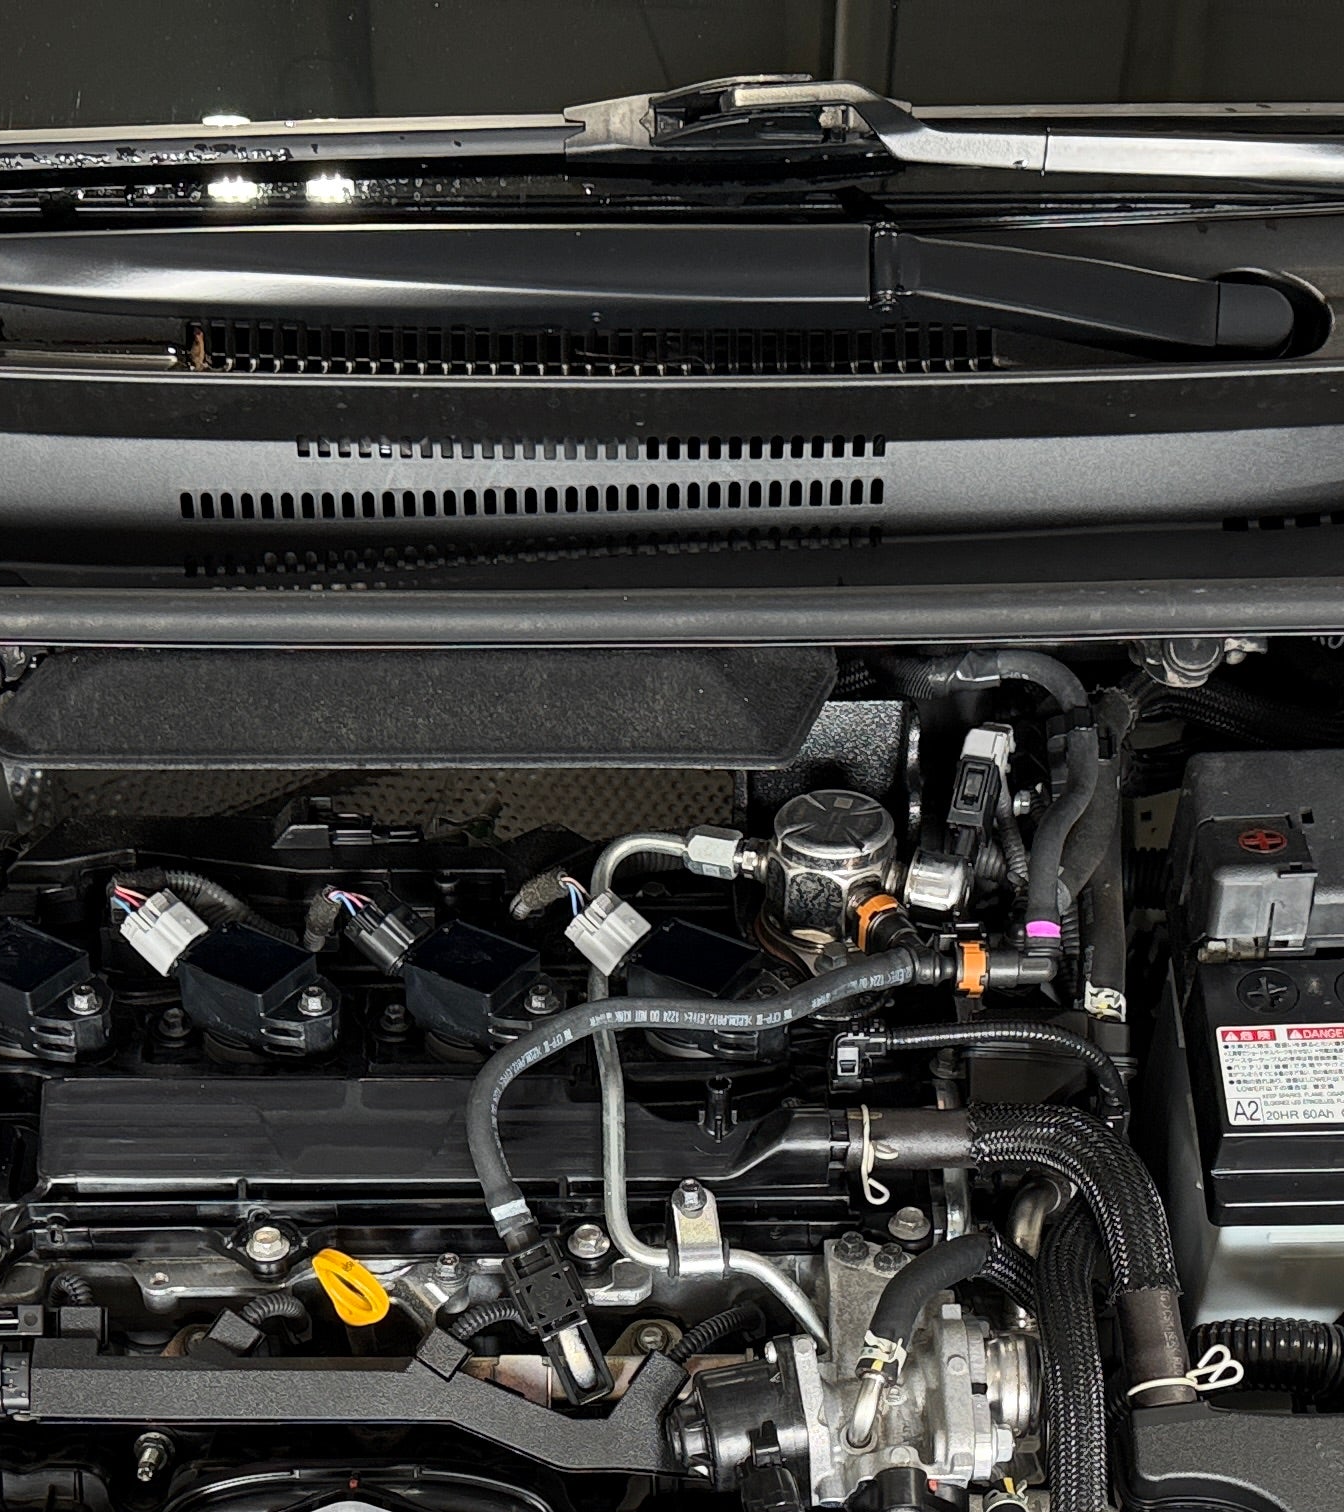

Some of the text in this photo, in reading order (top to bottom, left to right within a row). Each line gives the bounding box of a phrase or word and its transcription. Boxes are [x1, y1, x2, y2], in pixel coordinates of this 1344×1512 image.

[1234, 1100, 1261, 1122] A2
[1265, 1110, 1299, 1120] 20HR
[1303, 1109, 1334, 1119] 60Ah
